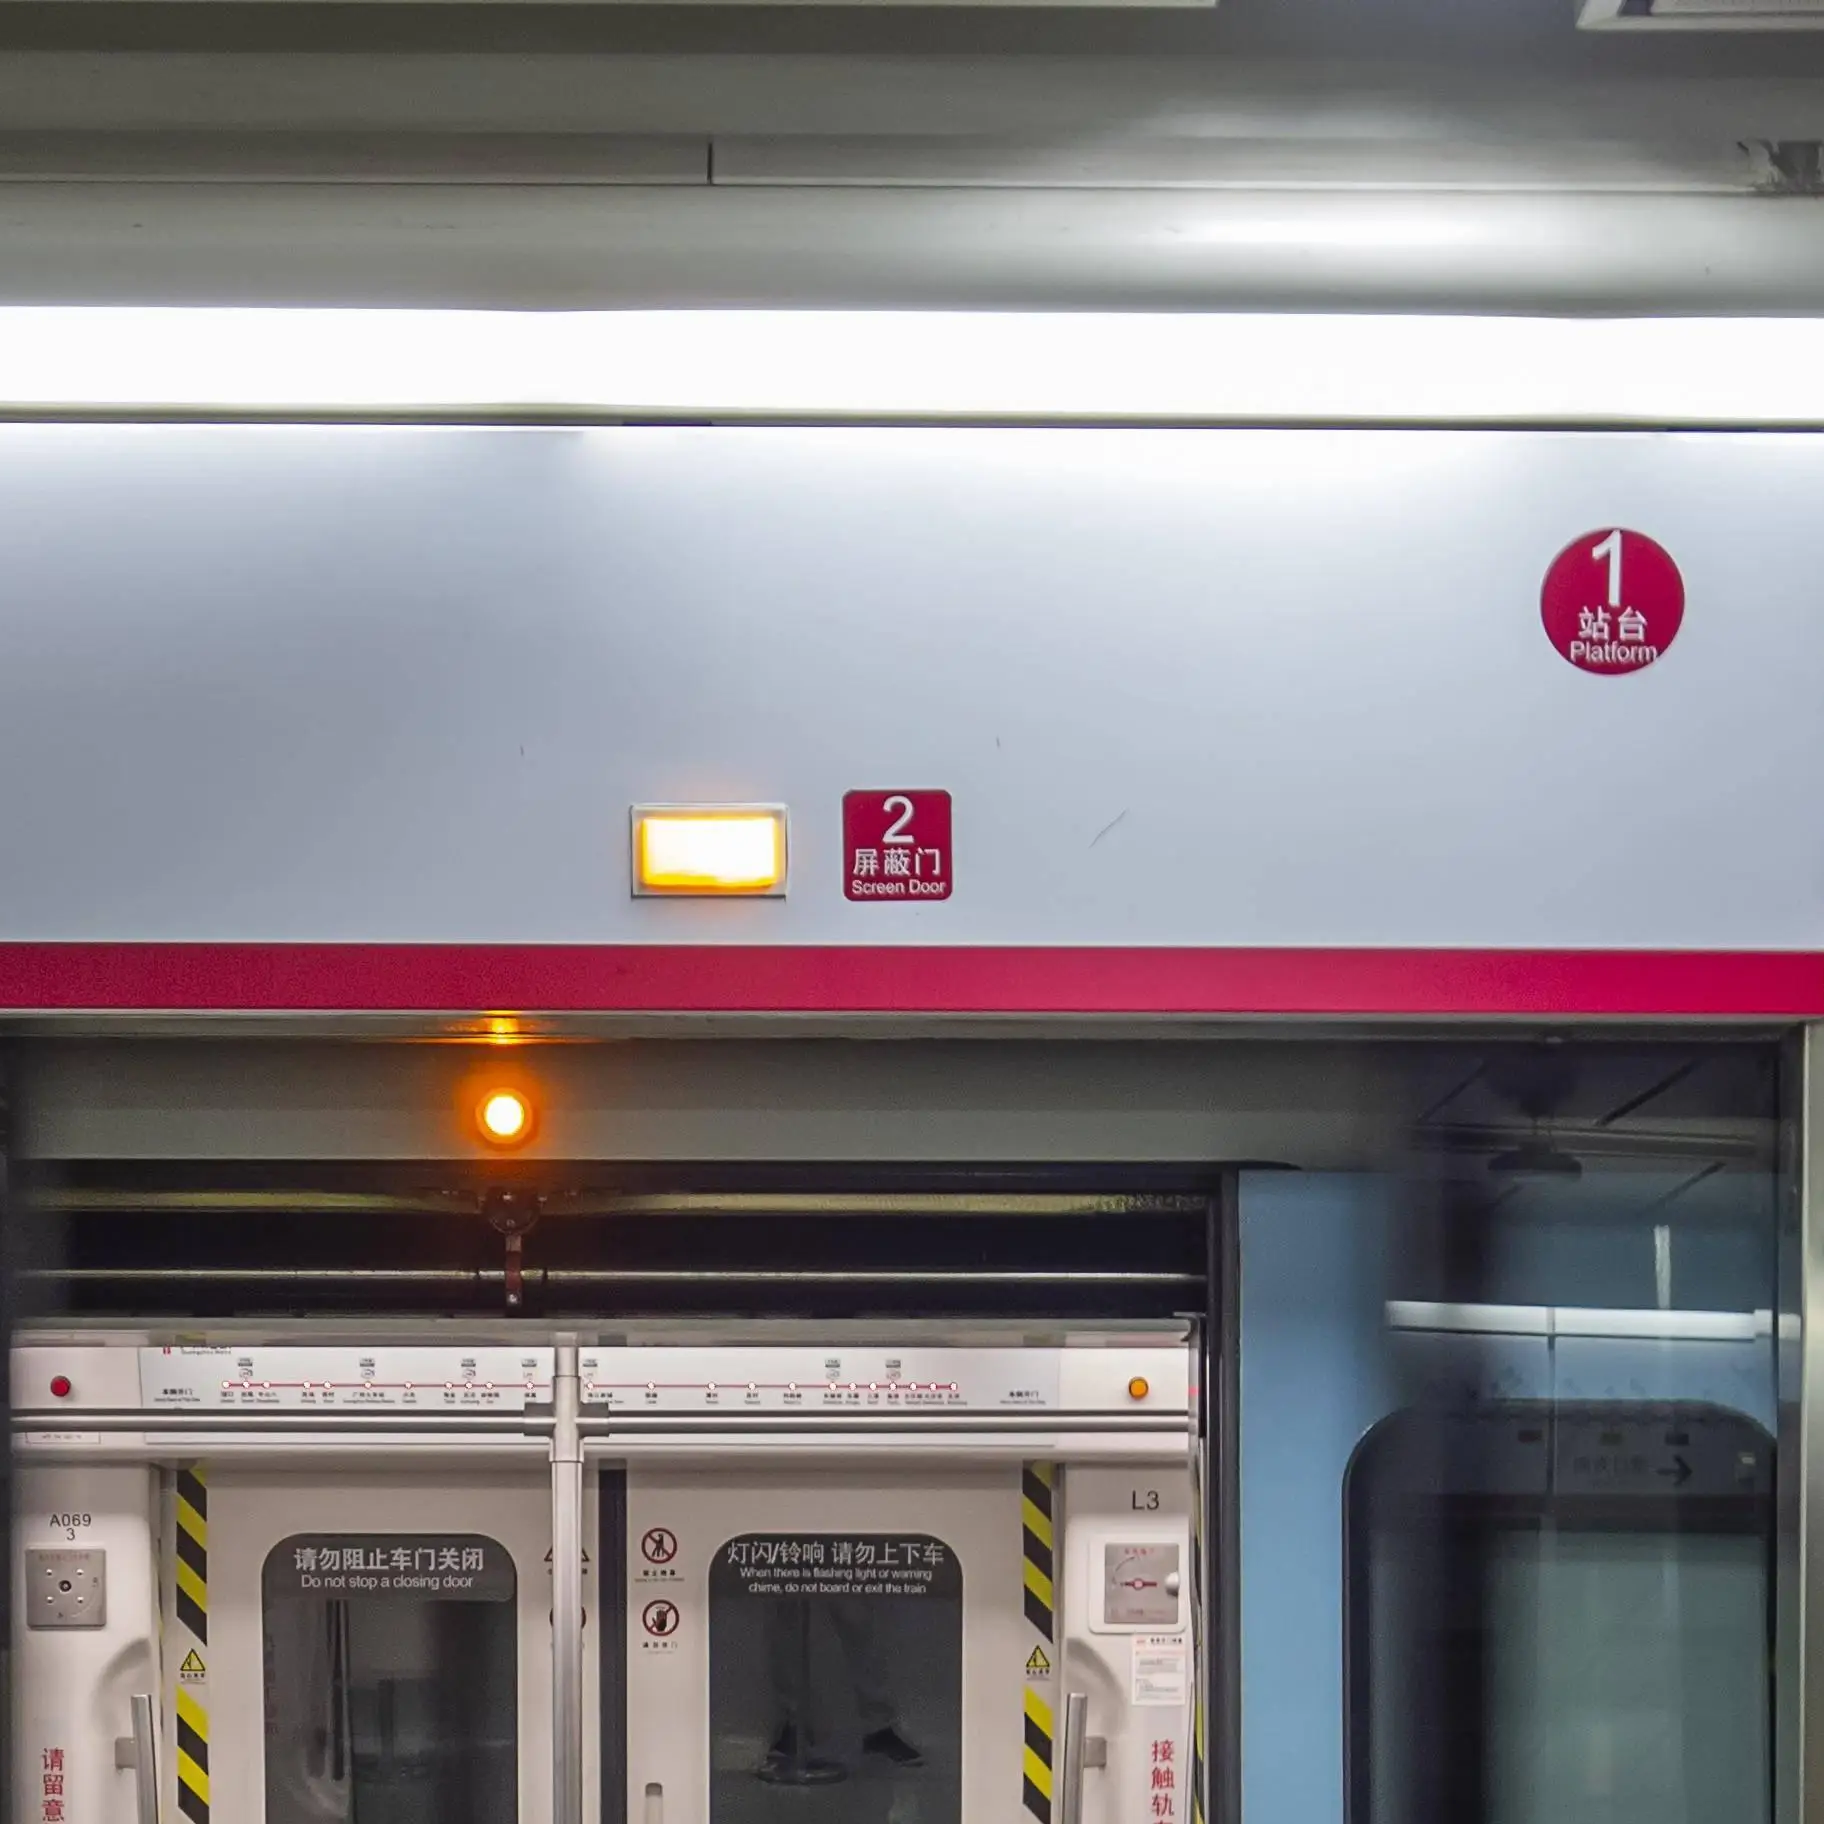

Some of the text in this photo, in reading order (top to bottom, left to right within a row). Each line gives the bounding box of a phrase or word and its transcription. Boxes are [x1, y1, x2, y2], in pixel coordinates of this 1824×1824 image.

[1591, 528, 1622, 608] 1
[1578, 606, 1648, 642] 站台
[1570, 641, 1657, 663] Platform
[882, 795, 915, 844] 2
[853, 847, 941, 877] 屏蔽门
[851, 879, 947, 895] Screen Door
[1132, 1490, 1160, 1511] L3
[49, 1513, 92, 1527] A069
[66, 1528, 75, 1541] 3
[293, 1547, 484, 1571] 请勿阻止车门关闭
[727, 1541, 945, 1566] 灯闪/铃响 请勿上下车
[301, 1575, 474, 1590] Do not stop a closing door
[739, 1568, 933, 1581] When there is flashing light or warning
[748, 1582, 927, 1594] chime, do not board or exit the train
